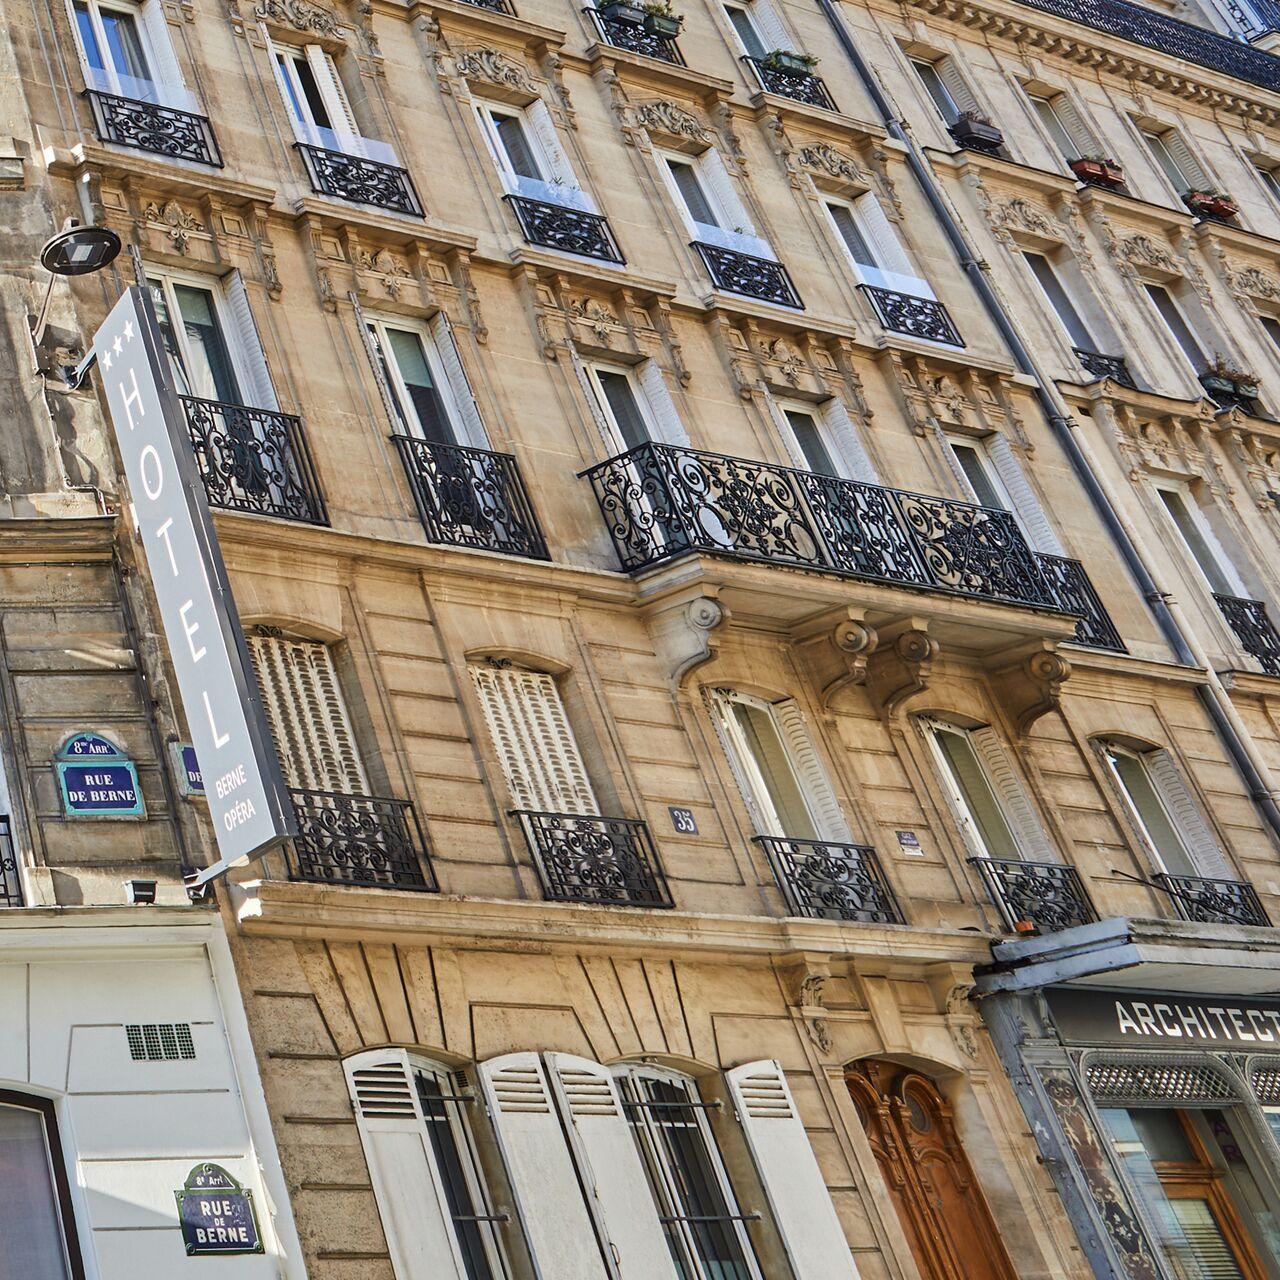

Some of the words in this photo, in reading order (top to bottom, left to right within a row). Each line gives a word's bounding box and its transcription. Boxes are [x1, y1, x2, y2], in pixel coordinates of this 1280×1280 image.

[119, 368, 230, 749] HOTEL
[85, 774, 114, 786] RUE
[215, 764, 248, 799] BERNE
[69, 791, 88, 802] DE
[90, 790, 136, 802] BERNE
[224, 798, 257, 832] OPÉRA
[673, 810, 695, 832] 35
[1115, 1000, 1280, 1042] ARCHITECT
[200, 1201, 232, 1216] RUE
[214, 1218, 225, 1226] DE
[196, 1227, 249, 1243] BERNE
